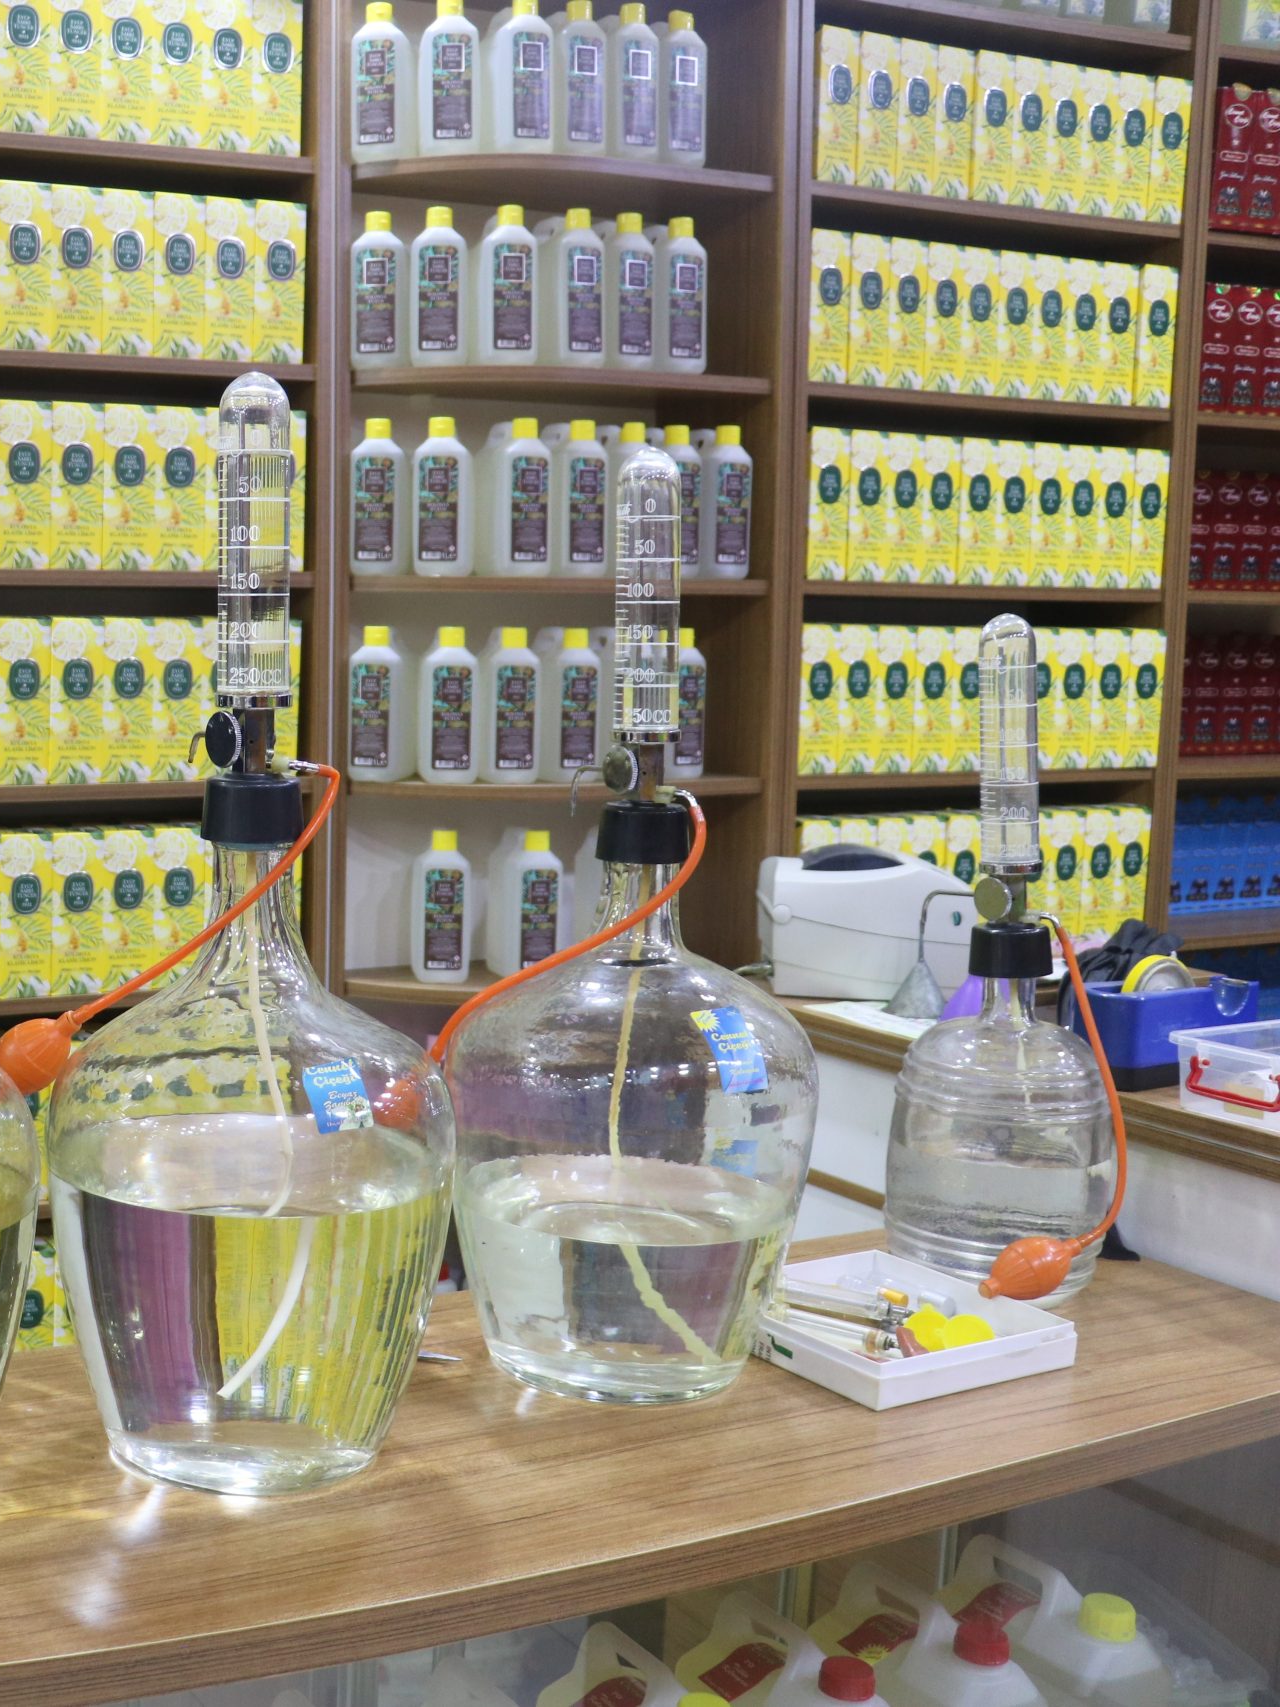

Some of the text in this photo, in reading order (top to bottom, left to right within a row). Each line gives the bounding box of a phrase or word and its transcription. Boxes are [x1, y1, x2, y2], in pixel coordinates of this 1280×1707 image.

[239, 476, 260, 493] 50
[645, 498, 656, 513] 0
[231, 525, 260, 542] 100
[635, 539, 655, 554] 50
[231, 573, 260, 589] 150
[627, 583, 654, 597] 100
[627, 625, 653, 639] 150
